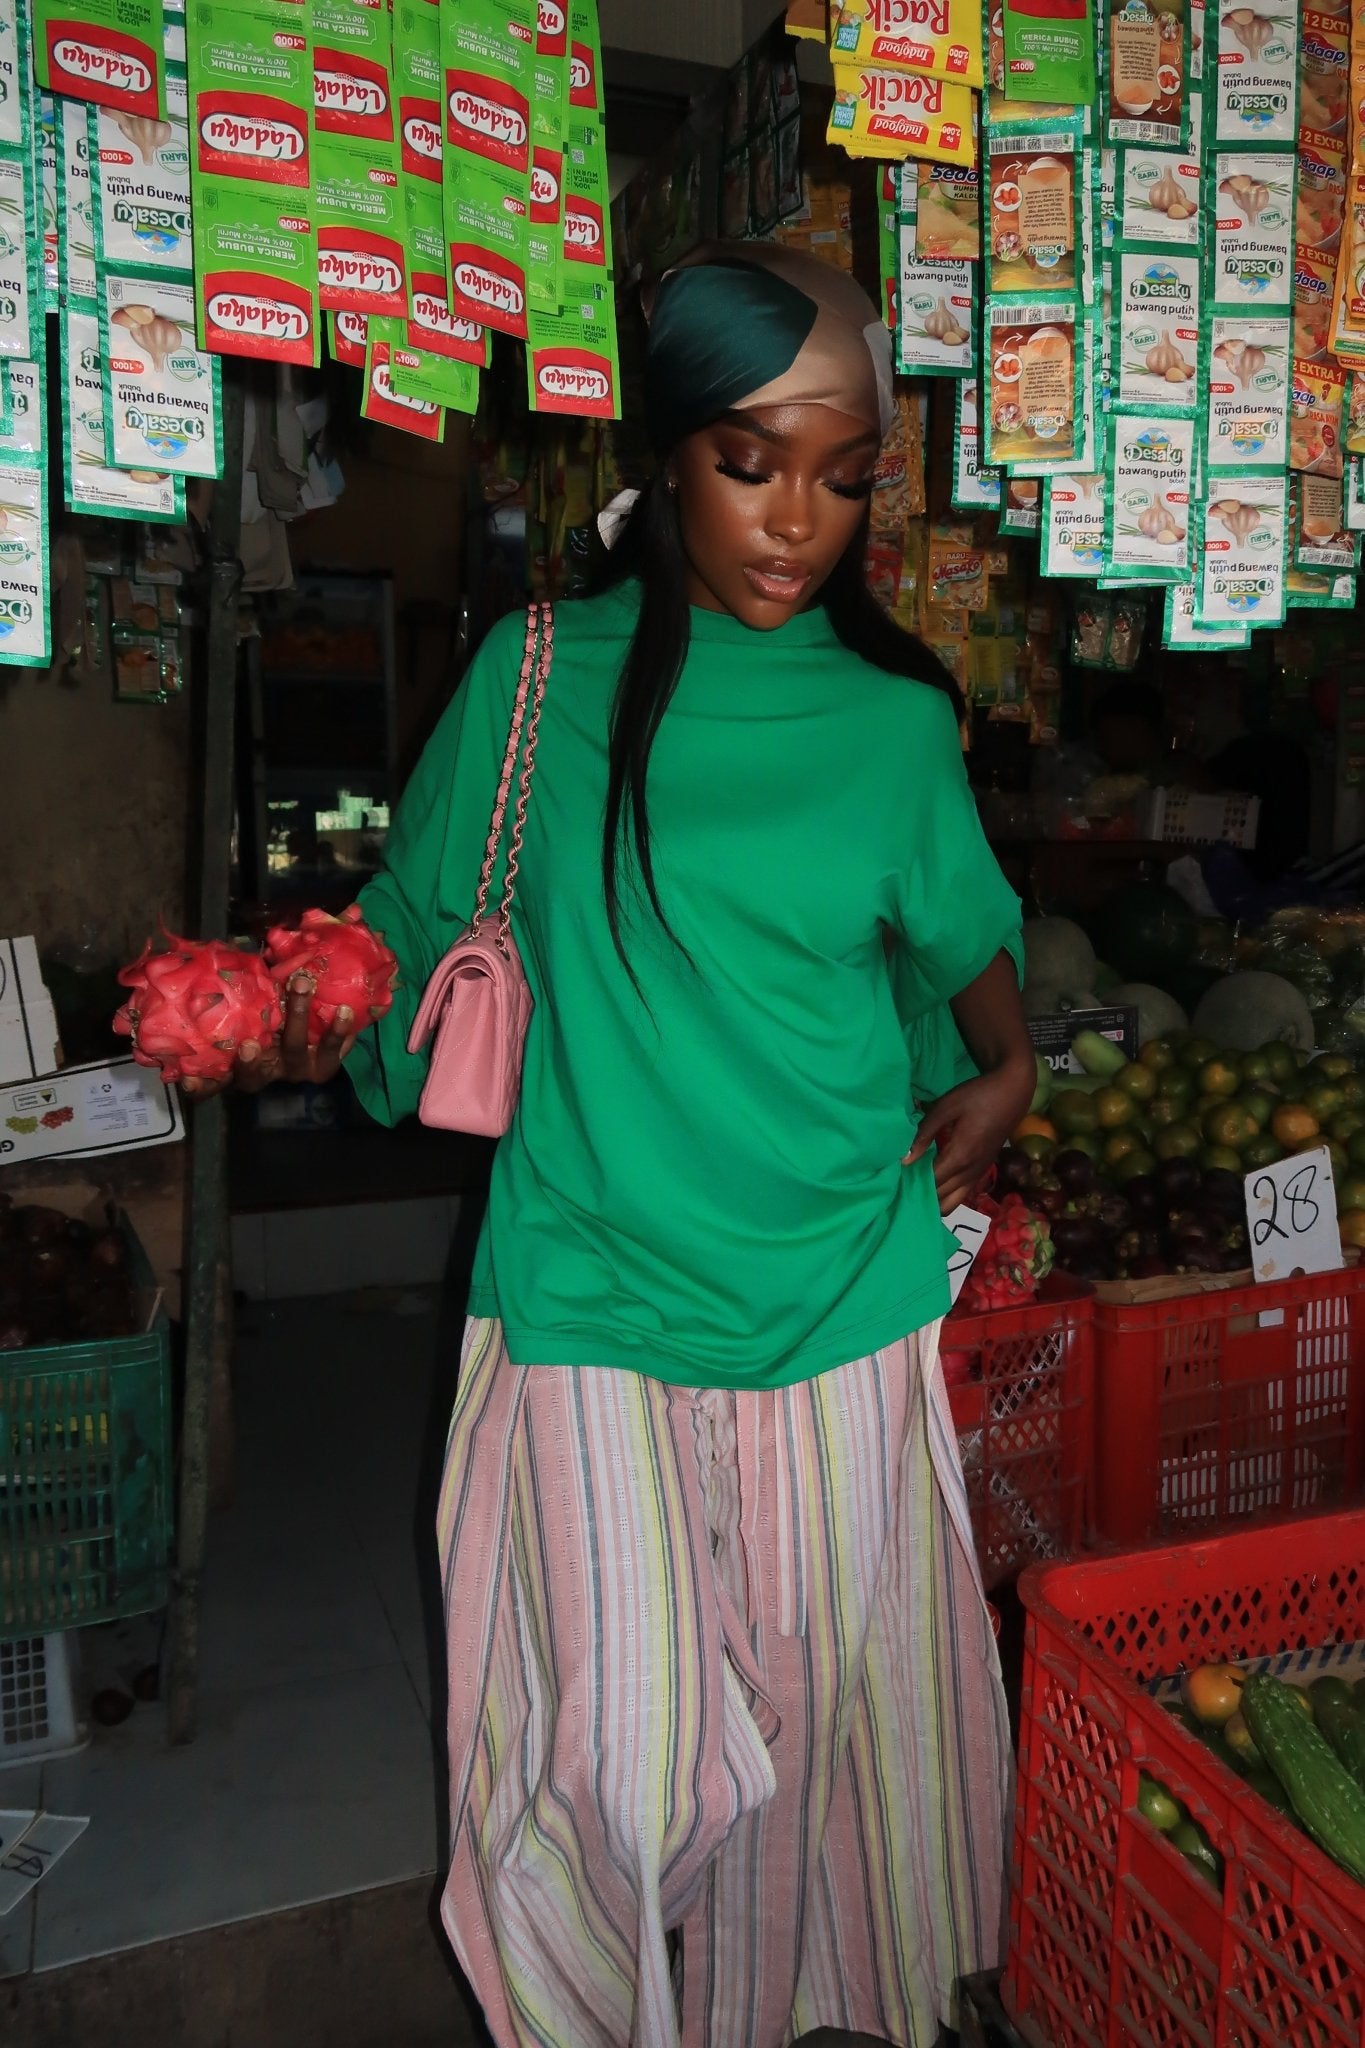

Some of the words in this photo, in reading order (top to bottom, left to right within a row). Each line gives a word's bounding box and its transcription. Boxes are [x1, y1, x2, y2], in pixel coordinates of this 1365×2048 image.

[116, 0, 151, 14] MURNI
[117, 8, 151, 23] MERICA
[863, 0, 950, 35] Racik
[1119, 10, 1153, 25] Desaku
[117, 17, 141, 28] 100%
[333, 23, 369, 36] MERICA
[458, 28, 477, 41] Murni
[1021, 34, 1051, 43] MERICA
[1053, 36, 1079, 45] BUBUK
[456, 38, 487, 55] BUBUK
[878, 41, 929, 61] Indofood
[211, 48, 234, 60] Murni
[236, 52, 264, 64] Merica
[949, 48, 969, 59] 2.000
[62, 47, 145, 87] Ladaku
[210, 58, 248, 73] BUBUK
[266, 57, 288, 66] 100%
[489, 52, 520, 69] MERICA
[953, 58, 962, 66] Rp
[250, 65, 291, 79] MERICA
[1223, 78, 1251, 89] putih
[1253, 76, 1292, 90] bawang
[859, 73, 943, 114] Racik
[1227, 92, 1287, 115] Desaku
[457, 97, 522, 142] Ladaku
[875, 117, 923, 138] Indofood
[941, 126, 960, 137] 2.000
[210, 119, 297, 155] Ladaku
[946, 135, 954, 143] Rp
[161, 152, 188, 162] BARU
[572, 168, 598, 178] MURNI
[573, 175, 598, 184] MERICA
[107, 175, 130, 185] bubuk
[107, 182, 144, 195] putih
[147, 185, 190, 205] awang
[351, 201, 386, 215] MERICA
[115, 200, 190, 232] Desaku
[458, 214, 485, 230] BUBUK
[217, 229, 240, 238] Murni
[243, 232, 270, 243] Merica
[486, 226, 515, 242] MERICA
[217, 240, 254, 253] BUBUK
[272, 238, 293, 248] 100%
[1221, 243, 1248, 254] putih
[1250, 242, 1287, 255] bawang
[256, 246, 296, 261] MERICA
[1028, 244, 1065, 256] Desaku
[1225, 256, 1282, 278] Desaku
[904, 272, 943, 282] bawang
[944, 273, 968, 282] putih
[460, 269, 520, 311] Ladaku
[1130, 278, 1190, 300] Desaku
[1126, 303, 1167, 314] bawang
[1168, 304, 1195, 315] putih
[217, 299, 302, 335] Ladaku
[582, 323, 607, 333] MURNI
[583, 330, 607, 339] MERICA
[171, 359, 196, 369] BARU
[1300, 363, 1334, 380] EXTRA
[118, 383, 141, 392] bubuk
[545, 369, 604, 394] Ladaku
[118, 391, 155, 404] putih
[157, 393, 209, 414] bawang
[1214, 406, 1242, 416] putih
[1244, 405, 1283, 416] bawang
[126, 408, 198, 439] Desaku
[1219, 420, 1278, 439] Desaku
[1124, 443, 1182, 464] Desaku
[1118, 466, 1159, 477] bawang
[1161, 469, 1186, 479] putih
[1055, 515, 1082, 525] putih
[1059, 529, 1104, 549] esaku
[1209, 564, 1237, 573] putih
[1239, 563, 1279, 574] bawang
[1214, 577, 1273, 595] Desaku
[1253, 1164, 1320, 1246] 28
